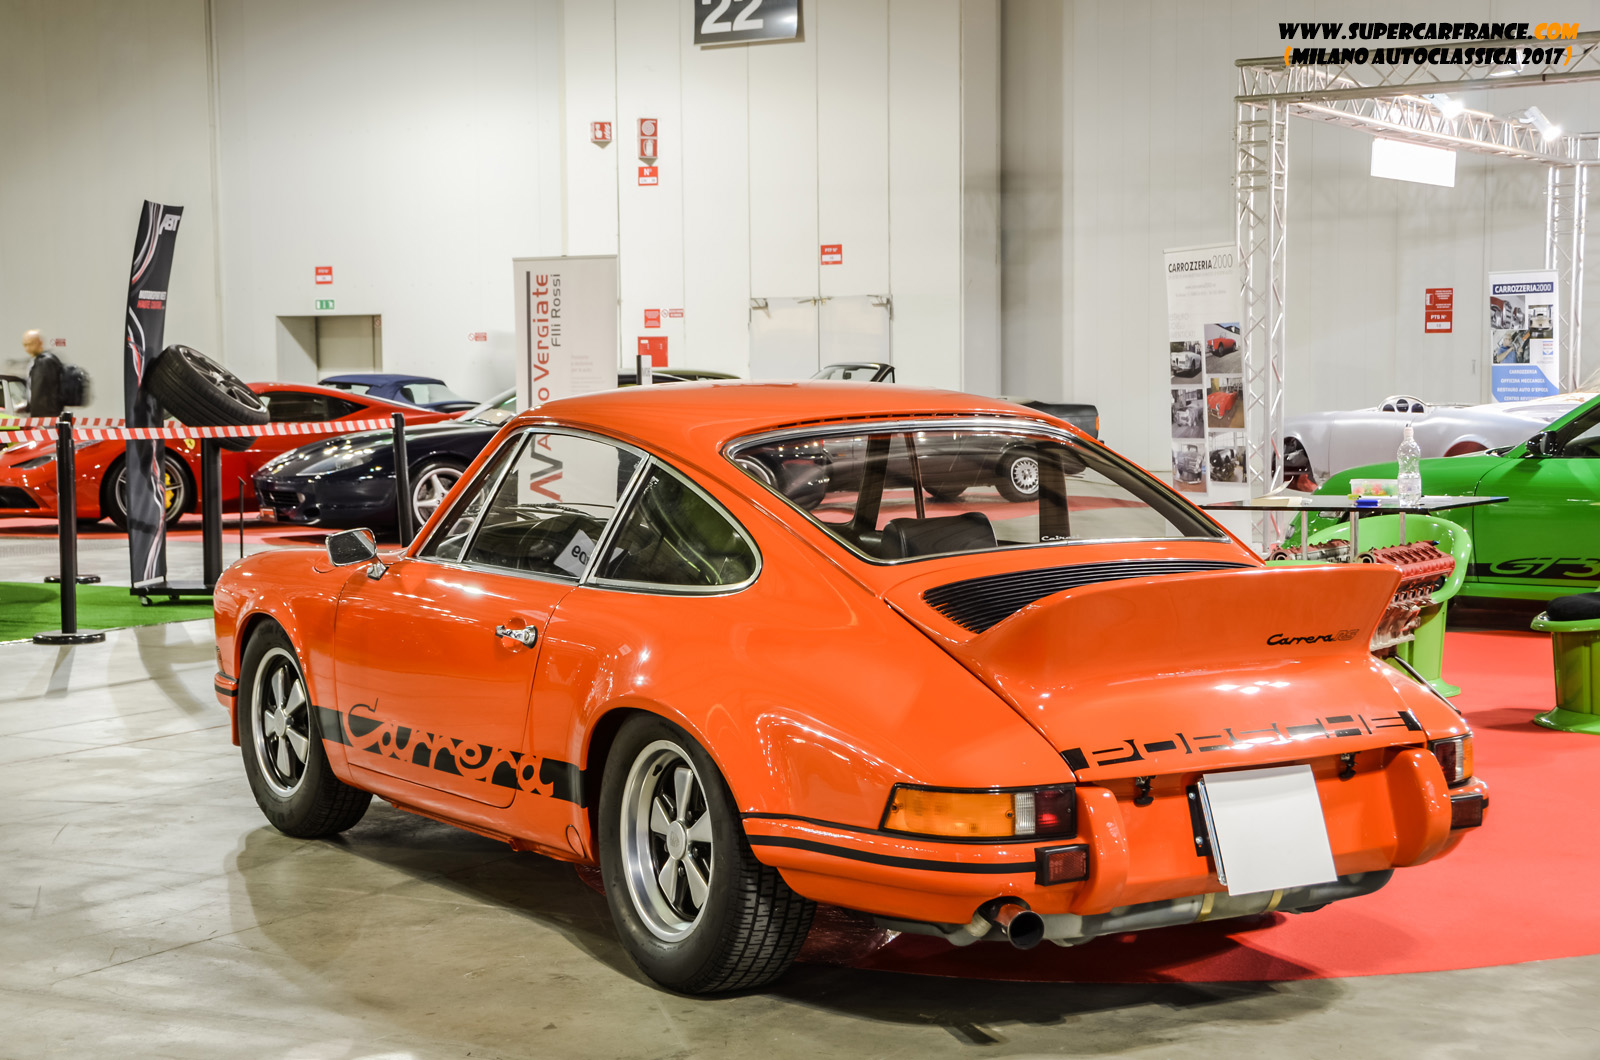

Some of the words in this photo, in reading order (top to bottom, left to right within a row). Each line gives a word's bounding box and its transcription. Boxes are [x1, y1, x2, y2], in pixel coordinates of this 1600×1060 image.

[700, 0, 764, 35] 22
[159, 213, 181, 235] ABT
[550, 273, 562, 318] Rossi
[1494, 283, 1552, 294] CARROZZERIA2000
[532, 273, 550, 382] Vergiate
[1489, 557, 1600, 578] GT3
[1266, 633, 1336, 646] Carrera
[343, 698, 554, 799] Carrera
